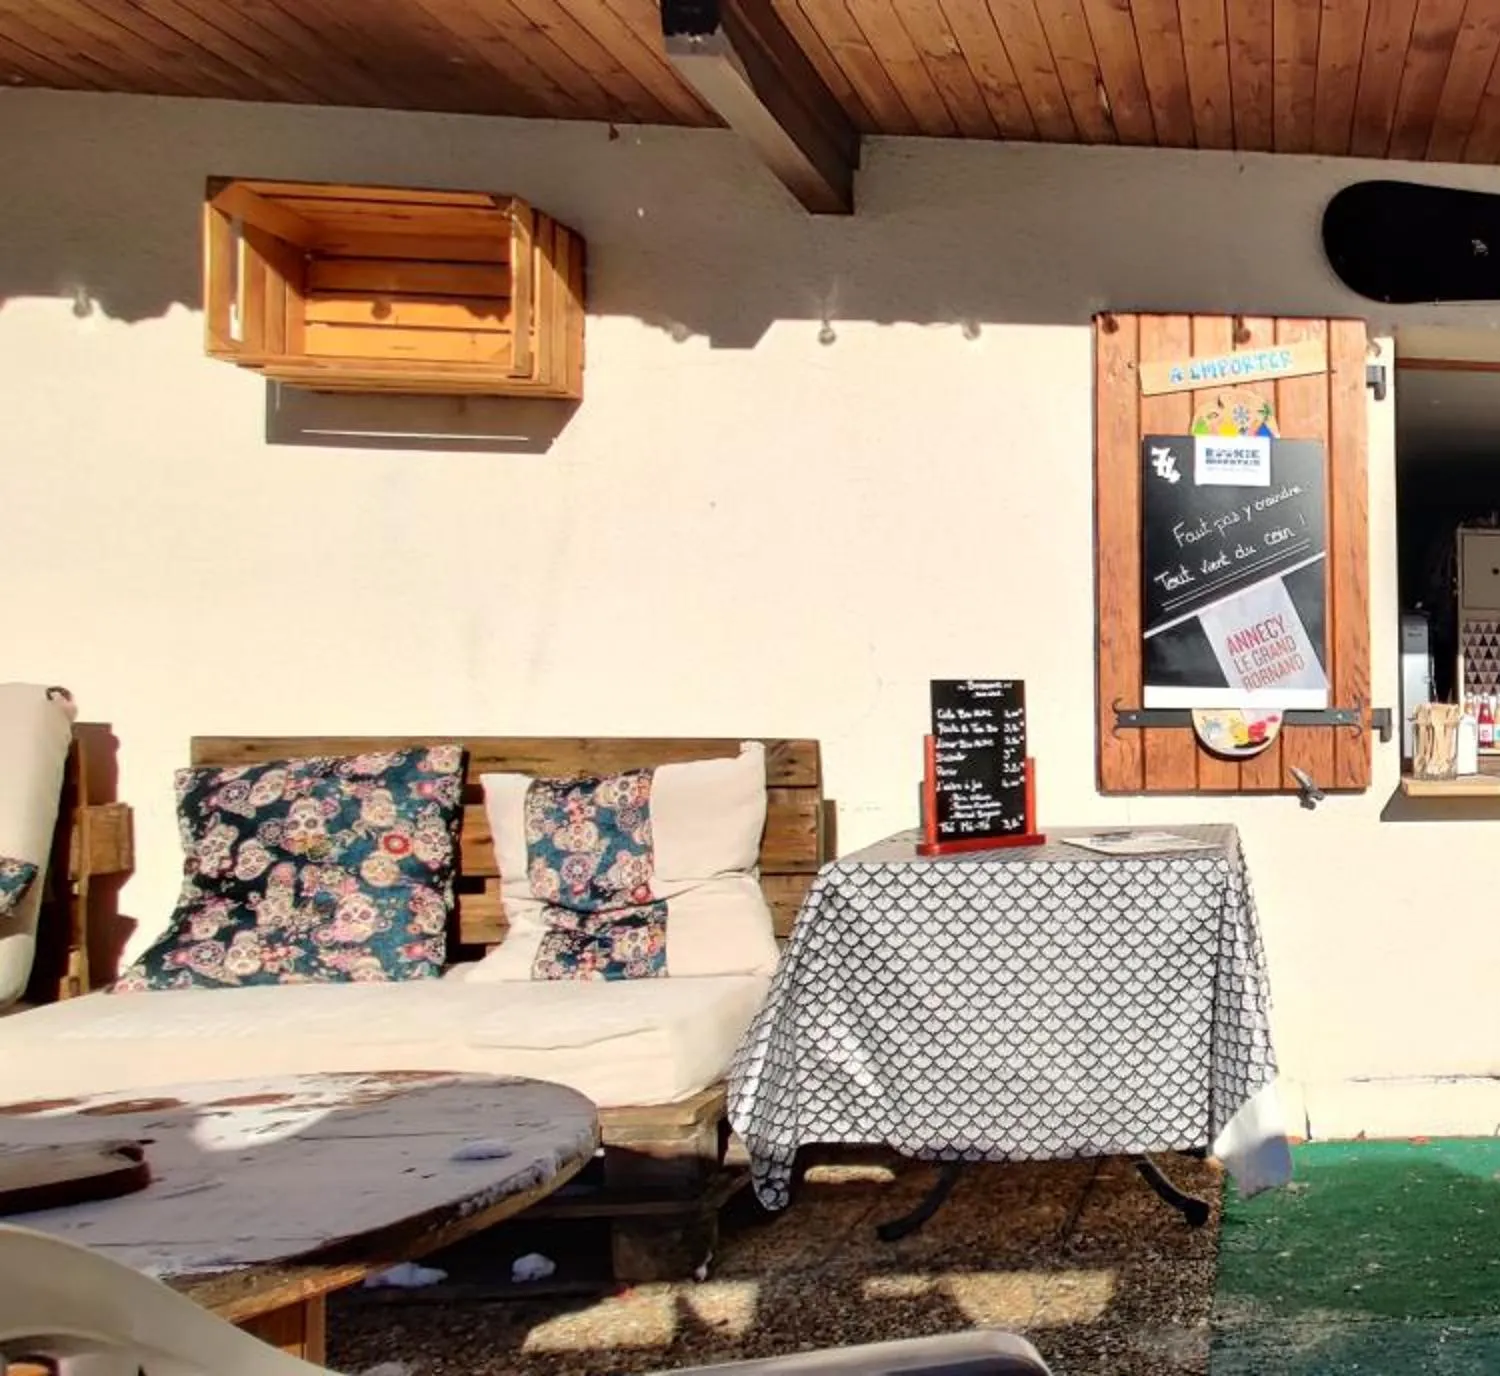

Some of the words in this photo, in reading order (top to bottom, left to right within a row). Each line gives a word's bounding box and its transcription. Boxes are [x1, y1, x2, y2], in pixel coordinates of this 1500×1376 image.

[1172, 516, 1211, 547] Faut
[1214, 511, 1240, 537] pas
[1154, 565, 1195, 591] Tout
[1200, 552, 1231, 575] vient
[1235, 544, 1256, 559] du
[1264, 526, 1296, 546] coin
[1226, 614, 1285, 657] ANNECY
[1233, 656, 1252, 675] LE
[1253, 635, 1297, 668] GRAND
[1241, 655, 1305, 693] BORNAND
